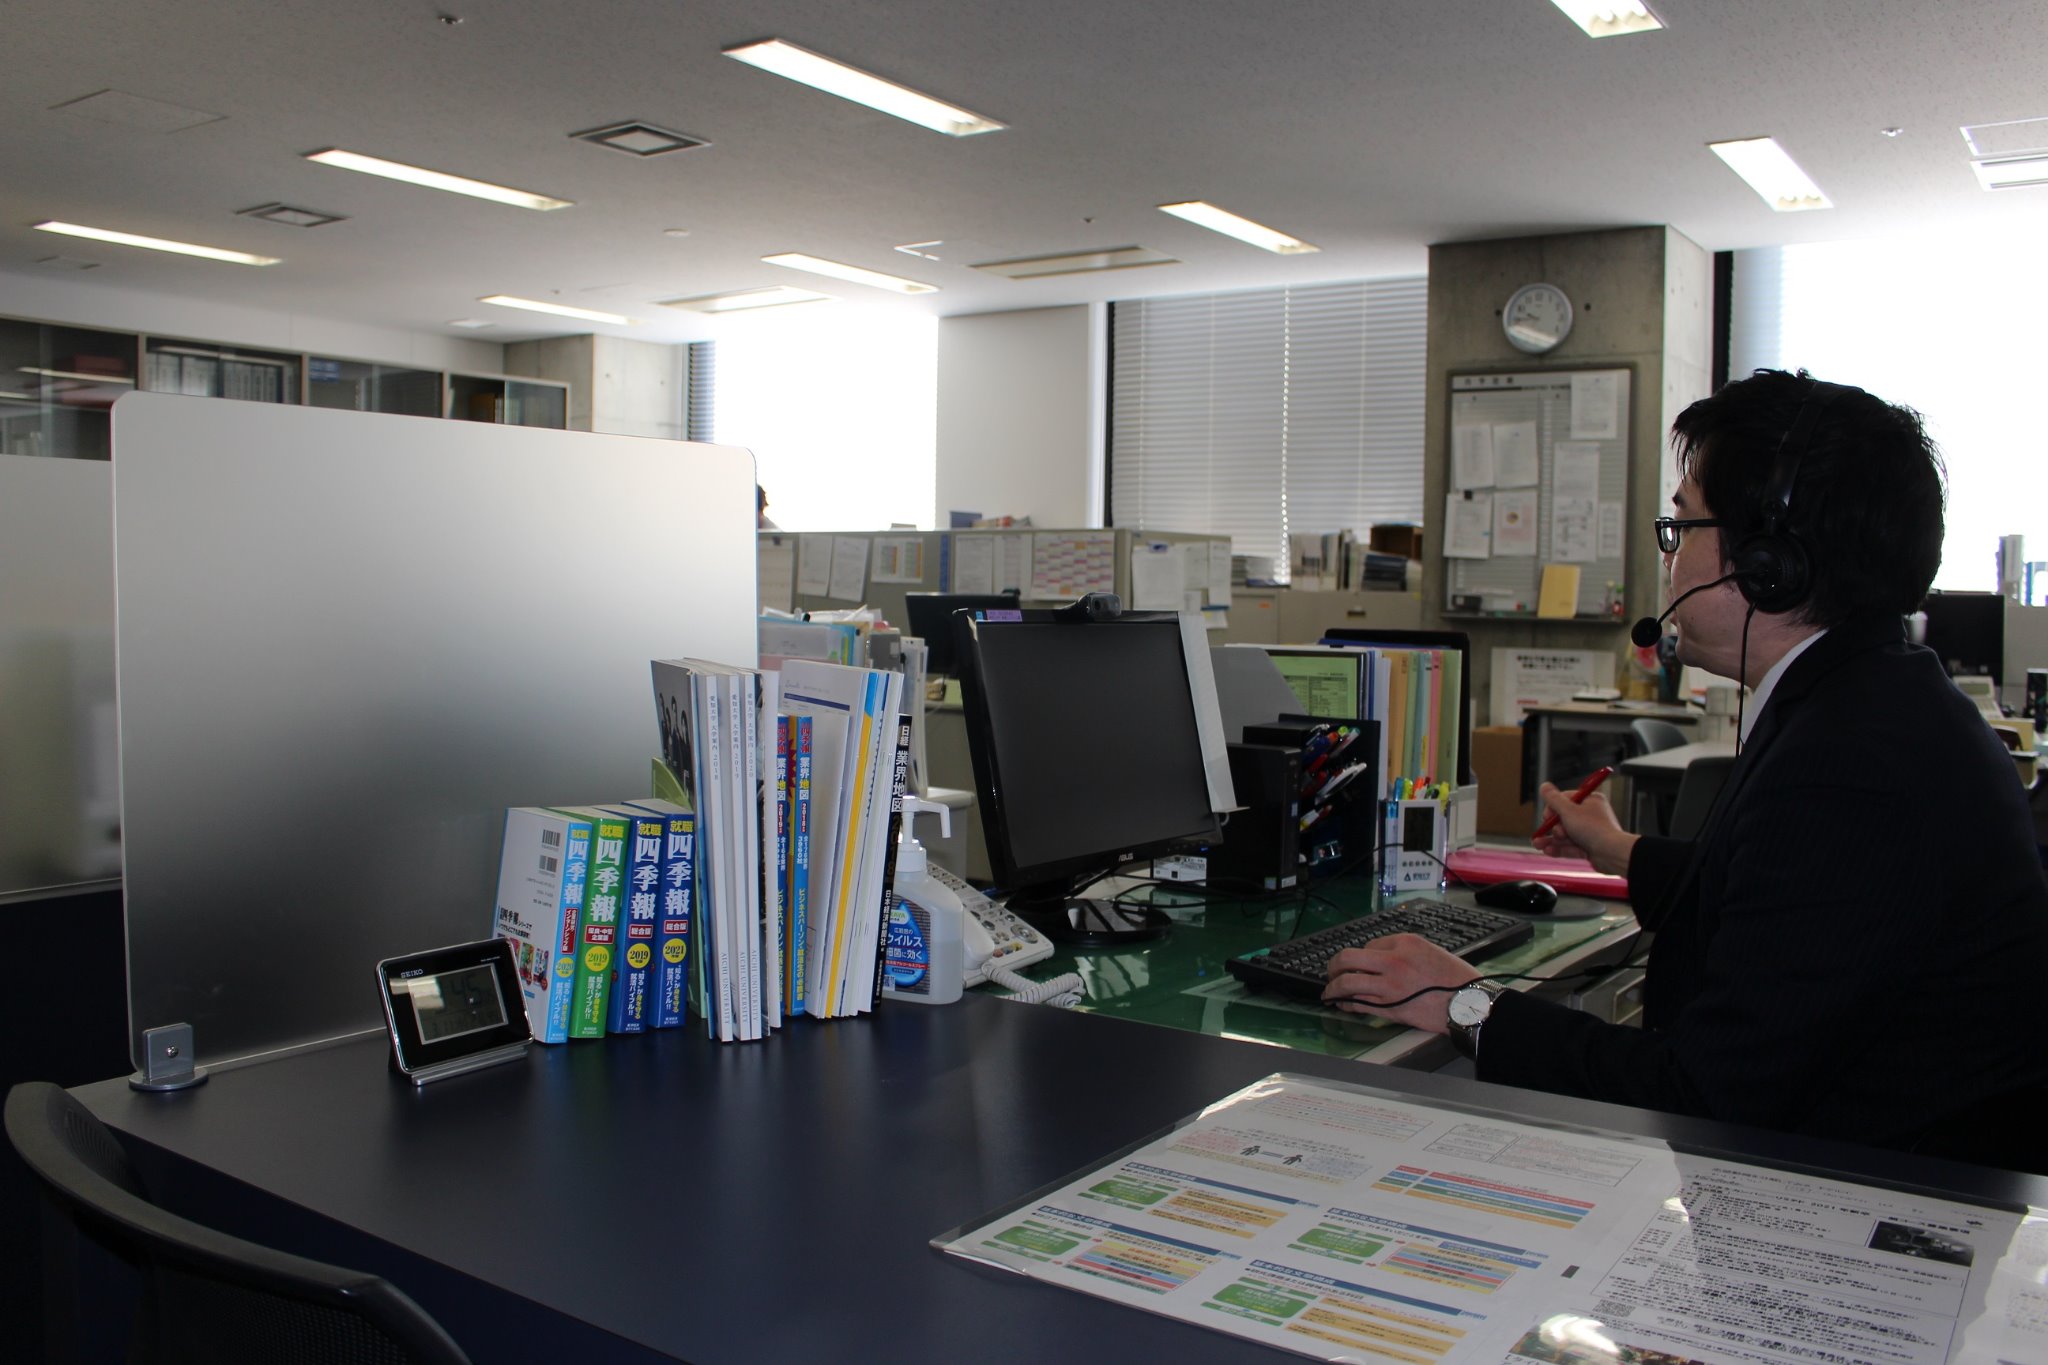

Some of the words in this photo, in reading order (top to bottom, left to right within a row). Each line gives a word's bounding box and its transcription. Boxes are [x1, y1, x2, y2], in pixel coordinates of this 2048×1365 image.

[901, 725, 910, 746] 日経
[800, 757, 811, 800] 業界地図
[891, 750, 909, 813] 業界地図
[601, 825, 624, 838] 就職
[639, 824, 662, 836] 就職
[670, 821, 693, 833] 就職
[1119, 853, 1134, 862] ASUS
[564, 839, 588, 905] 四季報
[590, 837, 623, 922] 四季報
[631, 837, 661, 920] 四季報
[664, 833, 693, 915] 四季報
[631, 927, 652, 935] 総合版
[666, 923, 687, 931] 総合版
[664, 945, 685, 955] 2021
[887, 934, 923, 947] ウイルス
[588, 951, 608, 962] 2019
[629, 949, 649, 960] 2019
[721, 952, 729, 975] AICHI
[739, 951, 747, 975] AICHI
[401, 968, 424, 979] SEIKO
[722, 978, 732, 1024] UNIVERSITY
[741, 977, 749, 1023] UNIVERSITY
[752, 975, 760, 1021] UNIVERSITY
